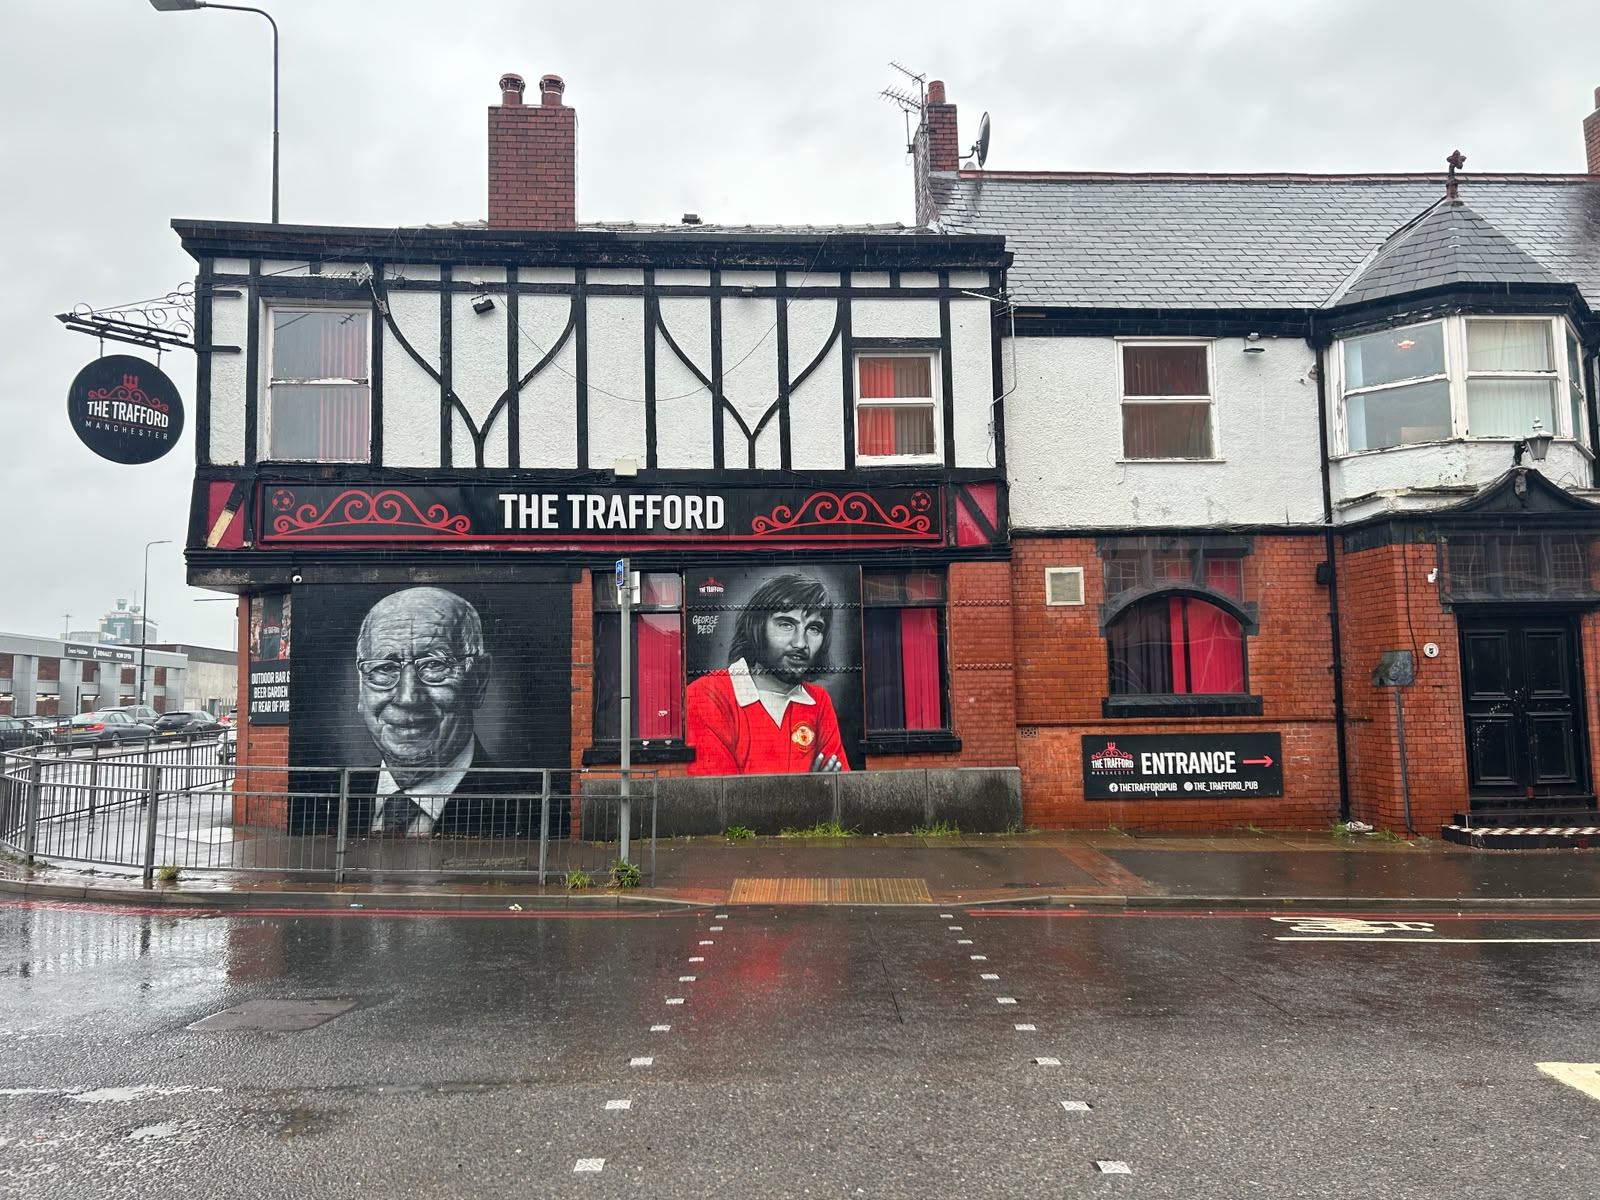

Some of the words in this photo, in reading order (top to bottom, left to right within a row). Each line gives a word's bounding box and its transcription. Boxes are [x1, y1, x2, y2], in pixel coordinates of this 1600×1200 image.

[87, 401, 109, 418] THE
[112, 401, 169, 428] TRAFFORD
[85, 420, 168, 440] MANCHESTER
[499, 494, 559, 529] THE
[567, 494, 725, 530] TRAFFORD
[692, 615, 720, 625] GEORGE
[697, 624, 717, 635] BEST
[251, 672, 274, 685] OUTDOOR
[275, 671, 287, 683] BAR
[254, 687, 267, 698] BEER
[267, 686, 288, 698] GARDEN
[251, 701, 258, 713] AT
[258, 701, 272, 713] REAR
[272, 700, 279, 713] OF
[1091, 759, 1104, 769] THE
[1103, 757, 1134, 769] TRAFFORD
[1140, 751, 1237, 775] ENTRANCE
[1119, 782, 1178, 792] THETRAFFORDPUB
[1194, 781, 1258, 792] THE_TRAFFORD_PUB
